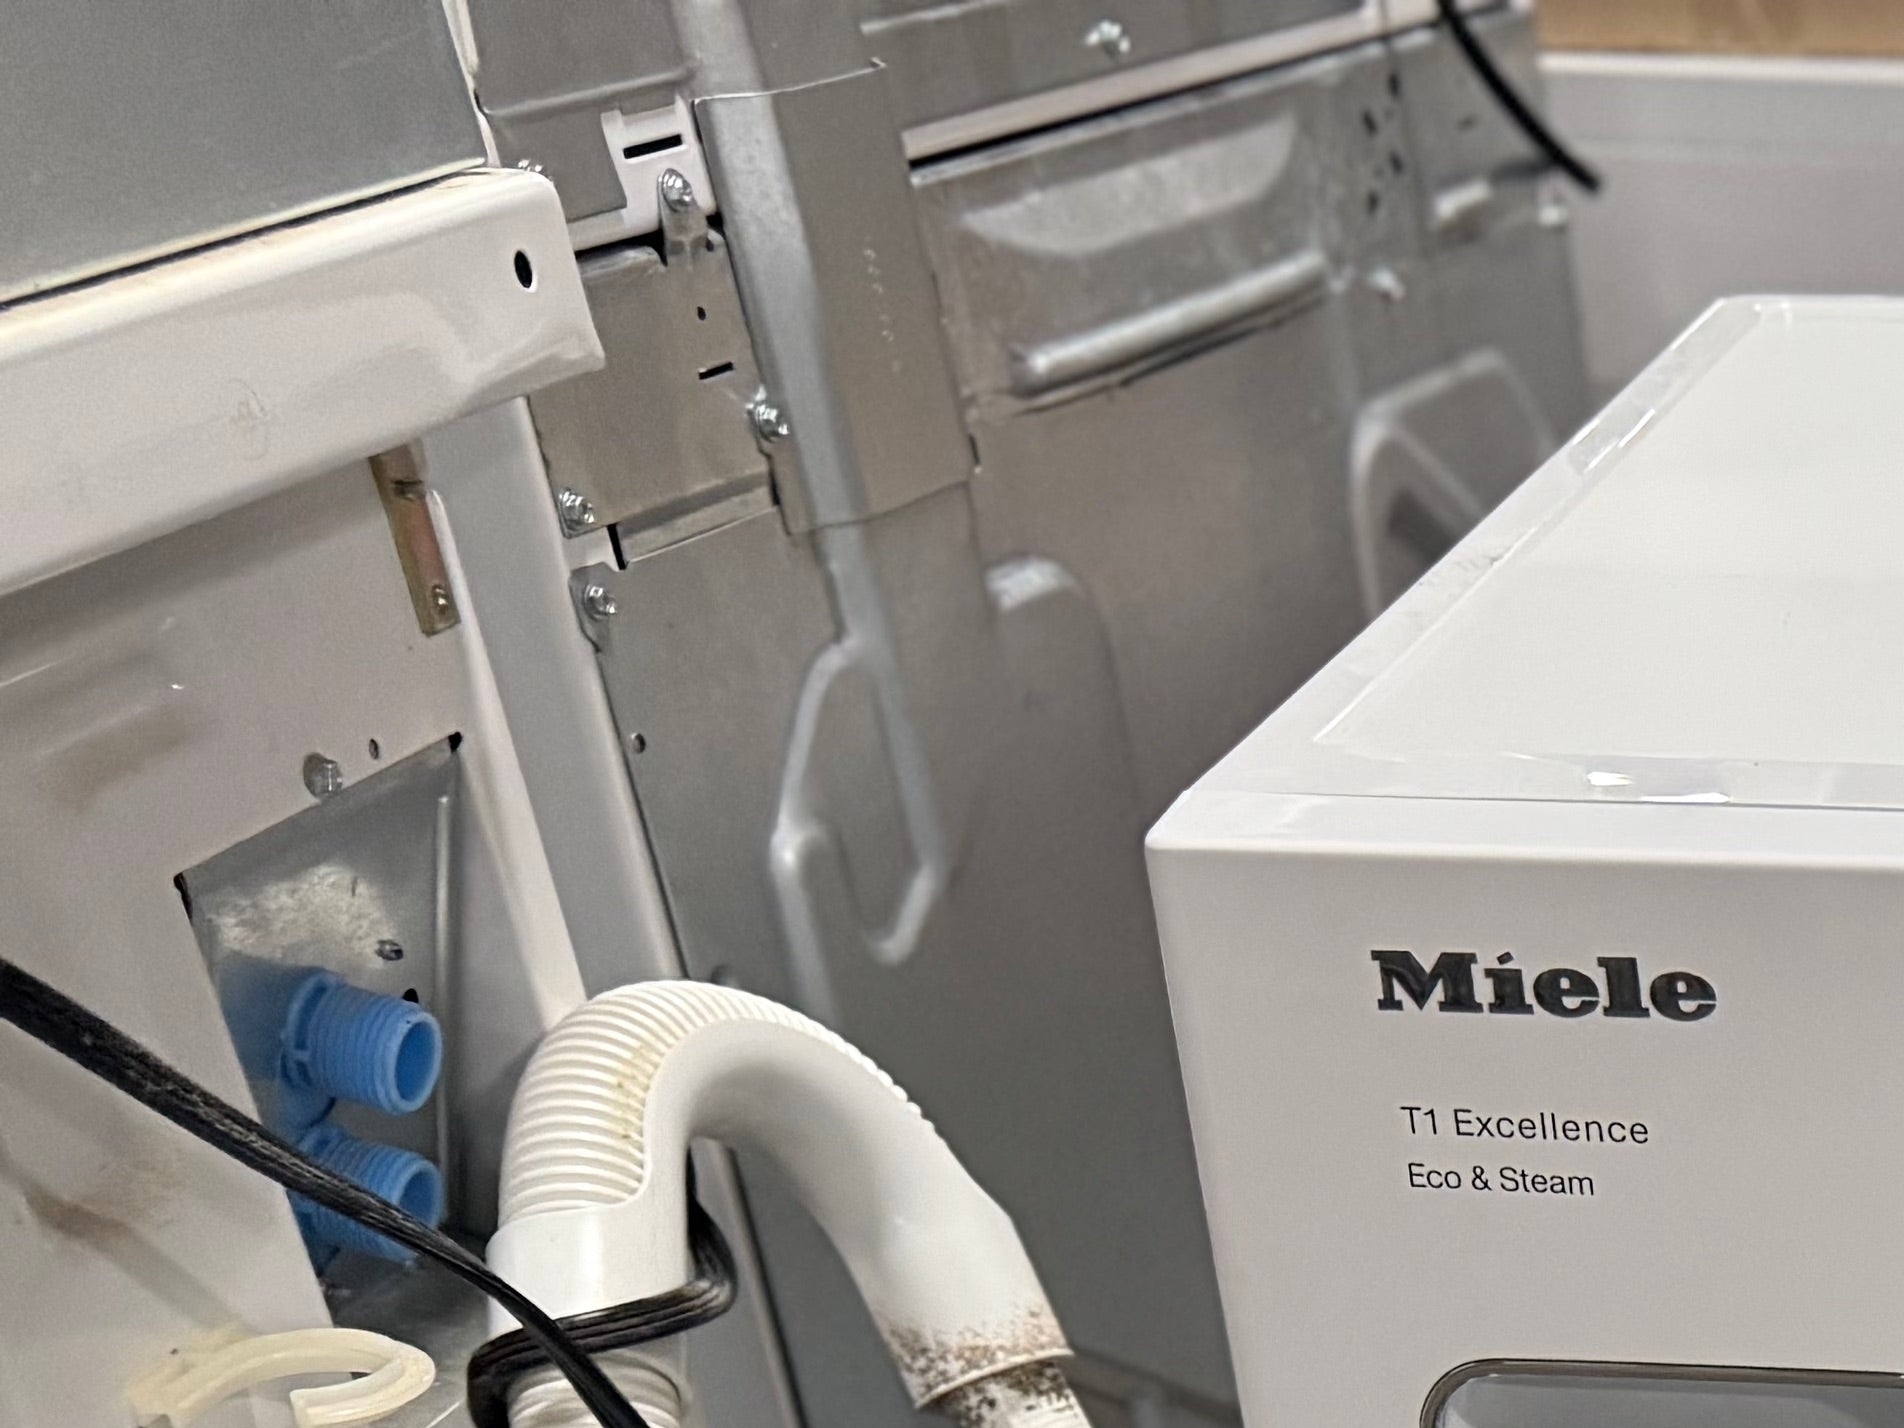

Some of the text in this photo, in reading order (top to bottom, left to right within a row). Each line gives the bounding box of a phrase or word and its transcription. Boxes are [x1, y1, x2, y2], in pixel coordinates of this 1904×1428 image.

[1370, 949, 1717, 1022] Miele
[1399, 1106, 1649, 1144] T1 Excellence
[1407, 1162, 1594, 1196] Eco & Steam
